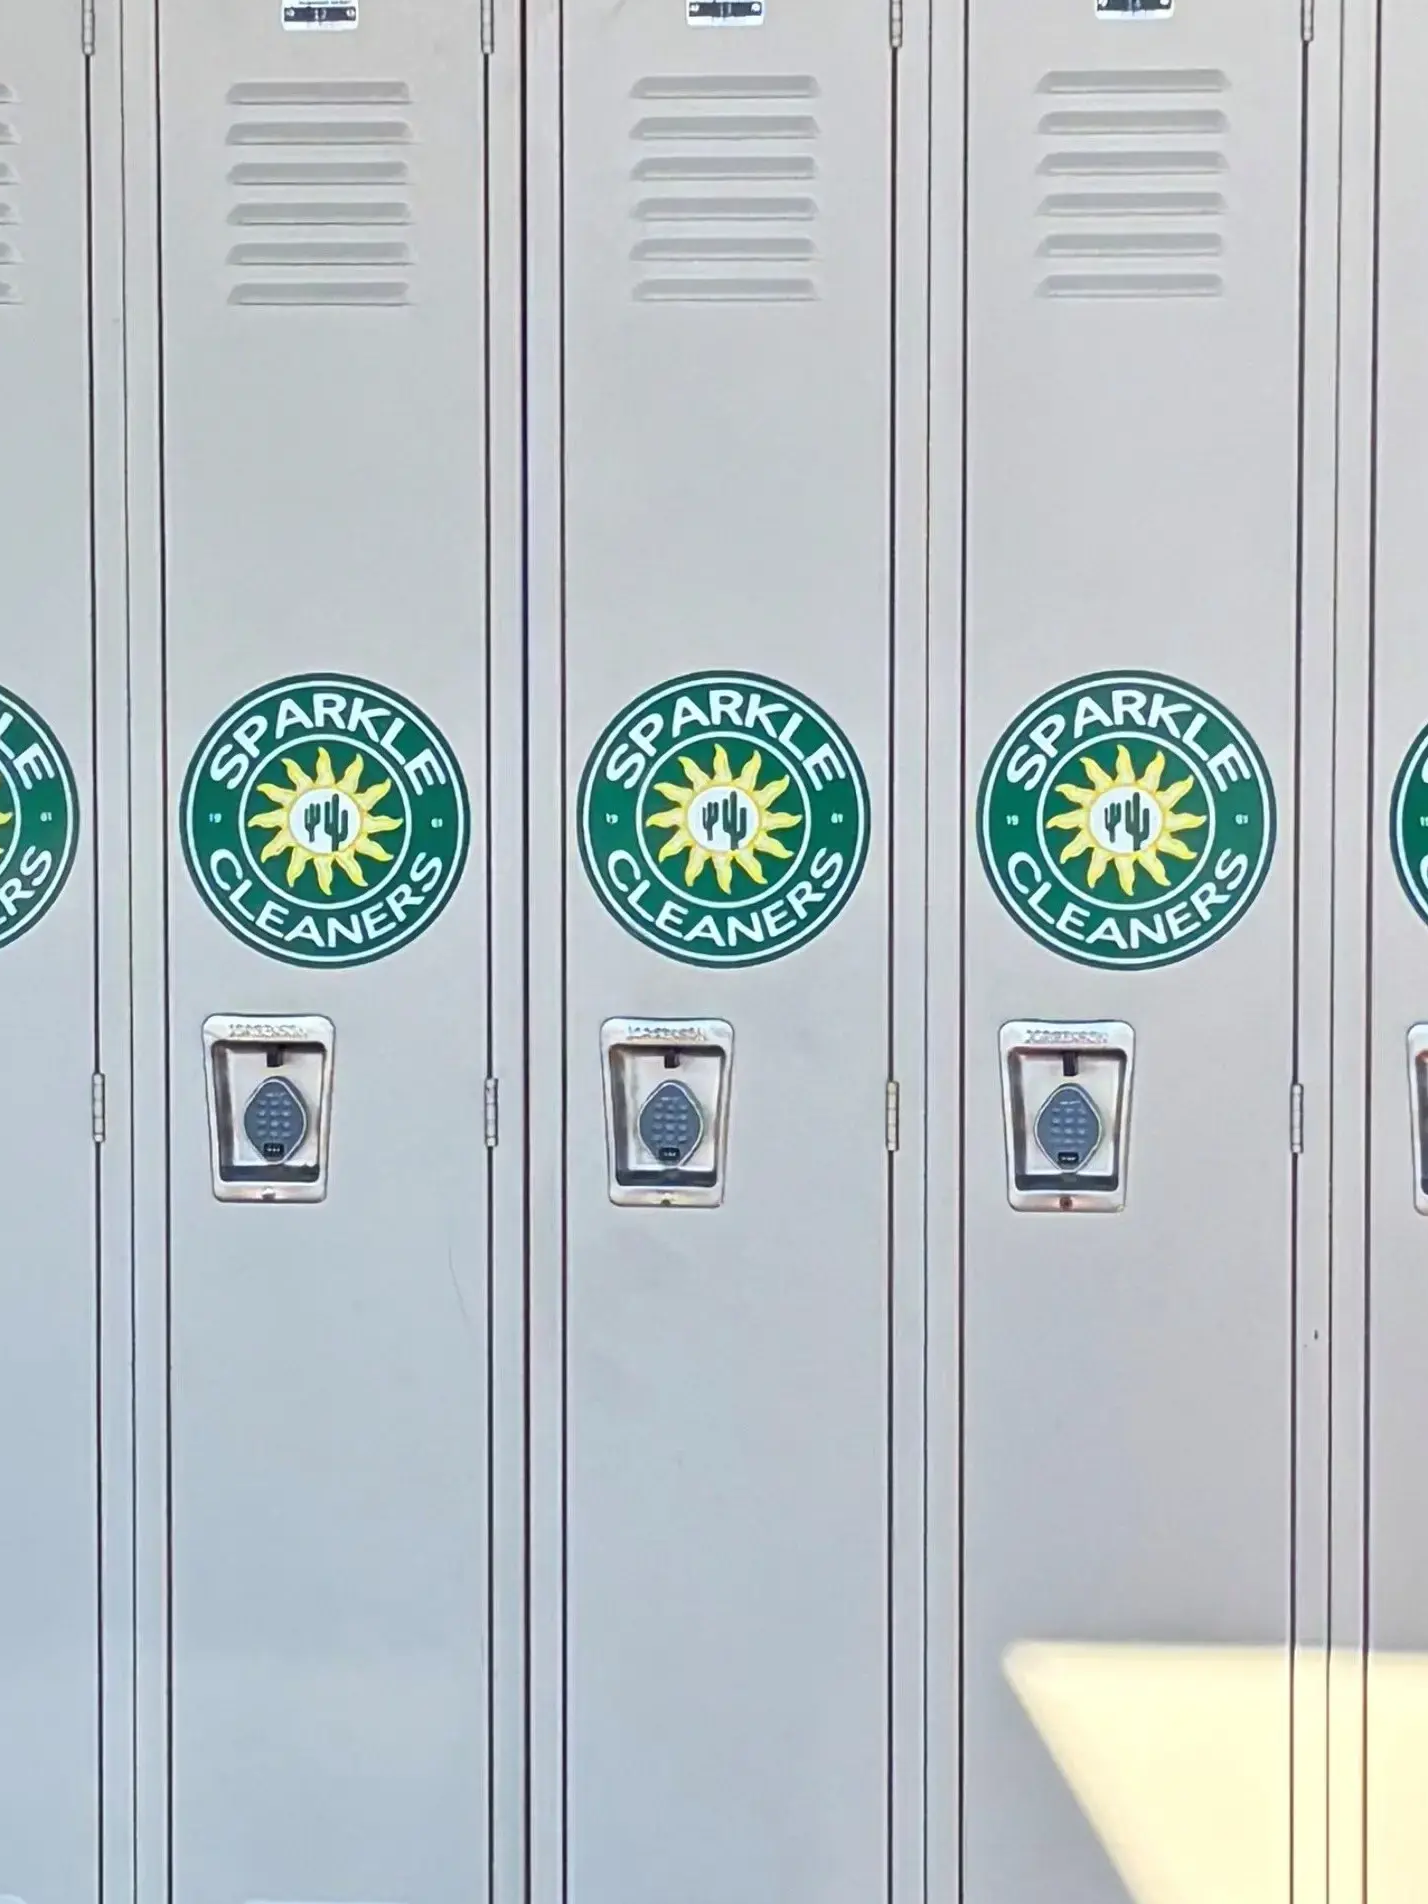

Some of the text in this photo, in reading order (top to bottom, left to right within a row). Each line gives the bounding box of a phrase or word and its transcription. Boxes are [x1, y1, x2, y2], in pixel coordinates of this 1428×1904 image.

[209, 693, 446, 795] SPARKLE
[606, 690, 846, 791] SPARKLE
[1006, 690, 1251, 792] SPARKLE
[210, 849, 442, 948] CLEANERS
[608, 847, 843, 946] CLEANERS
[1008, 848, 1248, 949] CLEANERS
